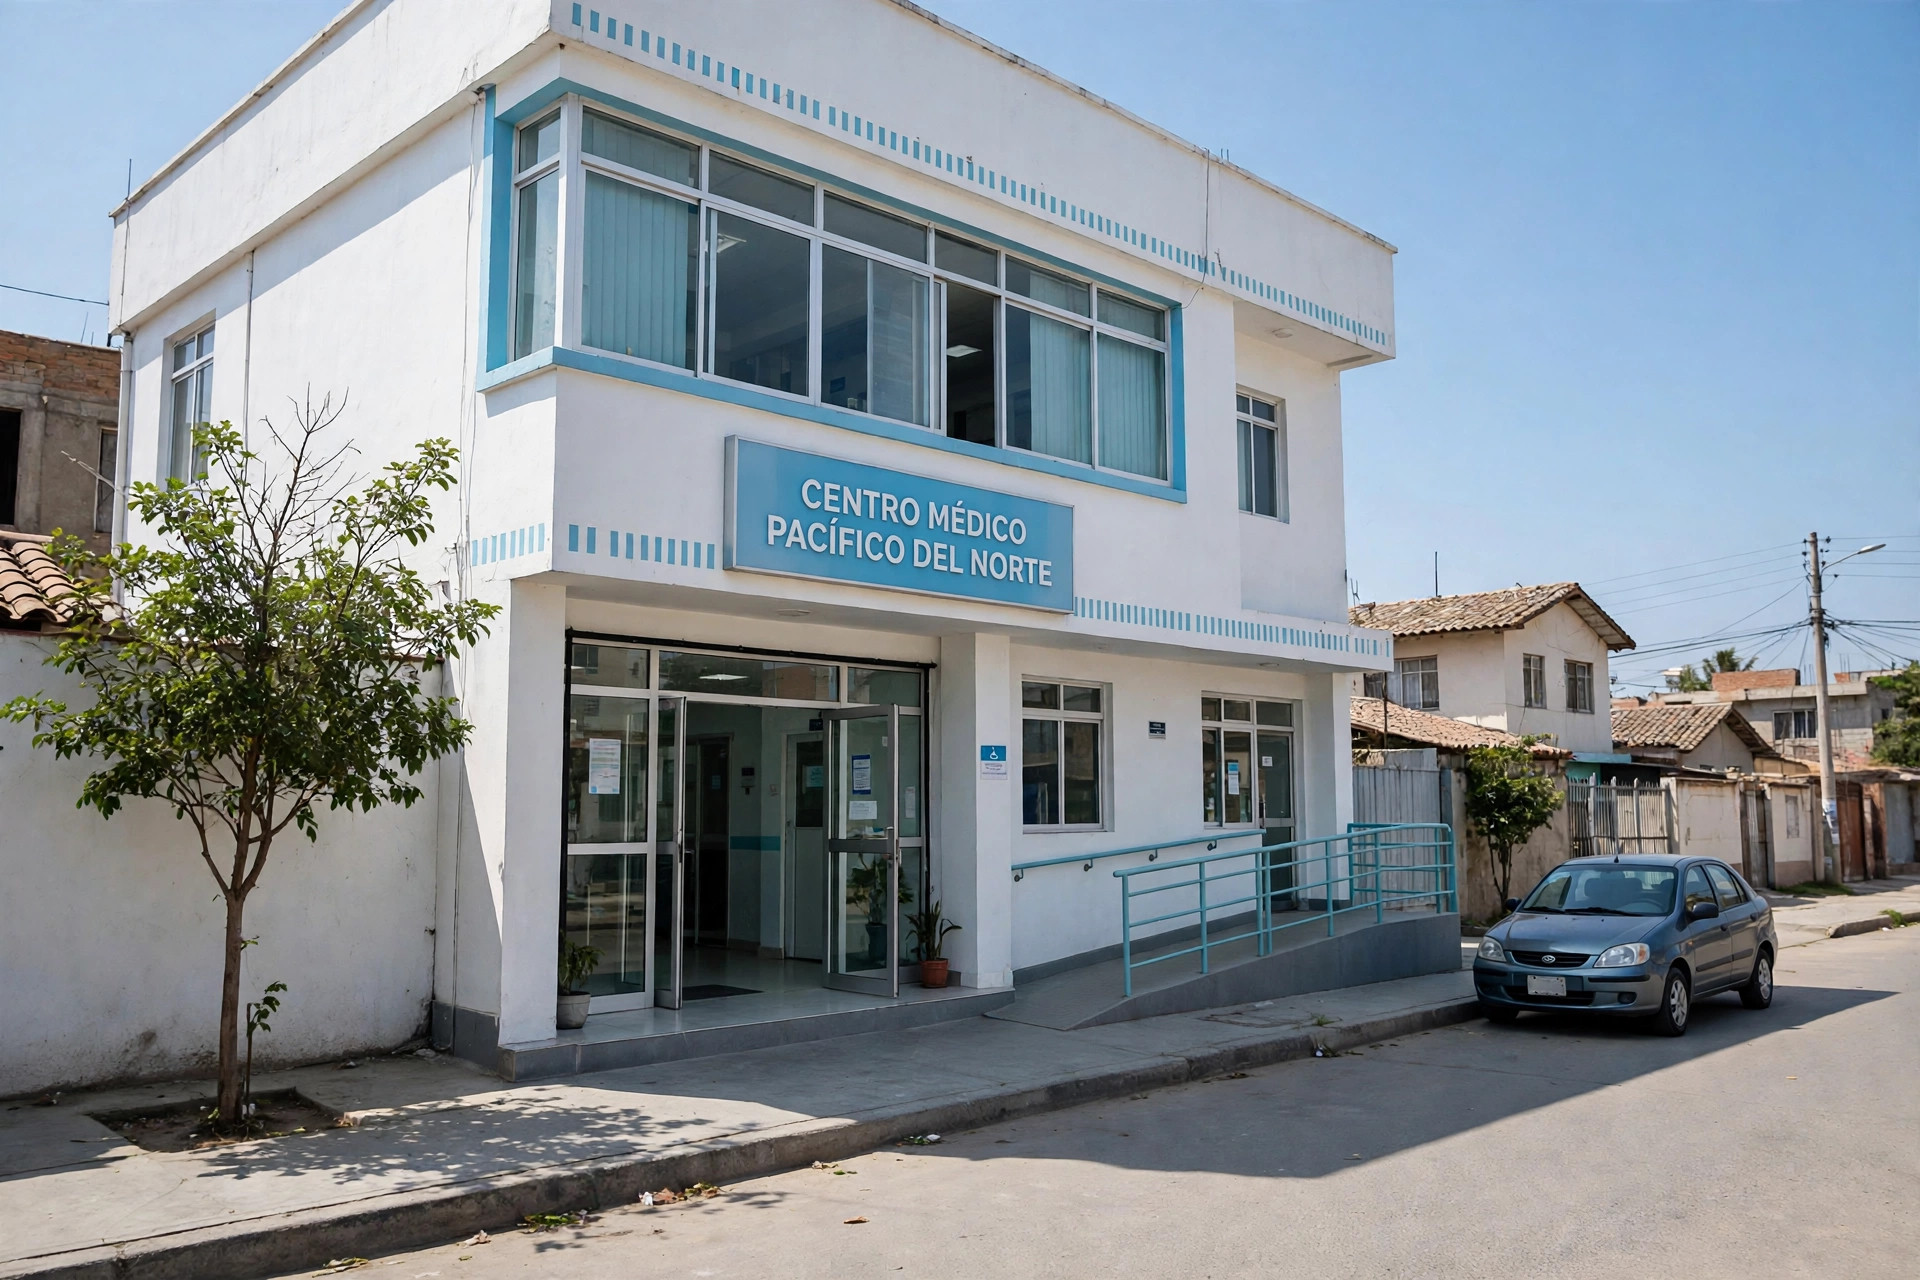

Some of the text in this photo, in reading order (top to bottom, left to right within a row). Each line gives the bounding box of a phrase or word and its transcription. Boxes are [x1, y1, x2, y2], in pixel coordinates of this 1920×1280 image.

[801, 479, 1027, 546] CENTRO MÉDICO
[767, 514, 1053, 588] PACÍFICO DEL NORTE
